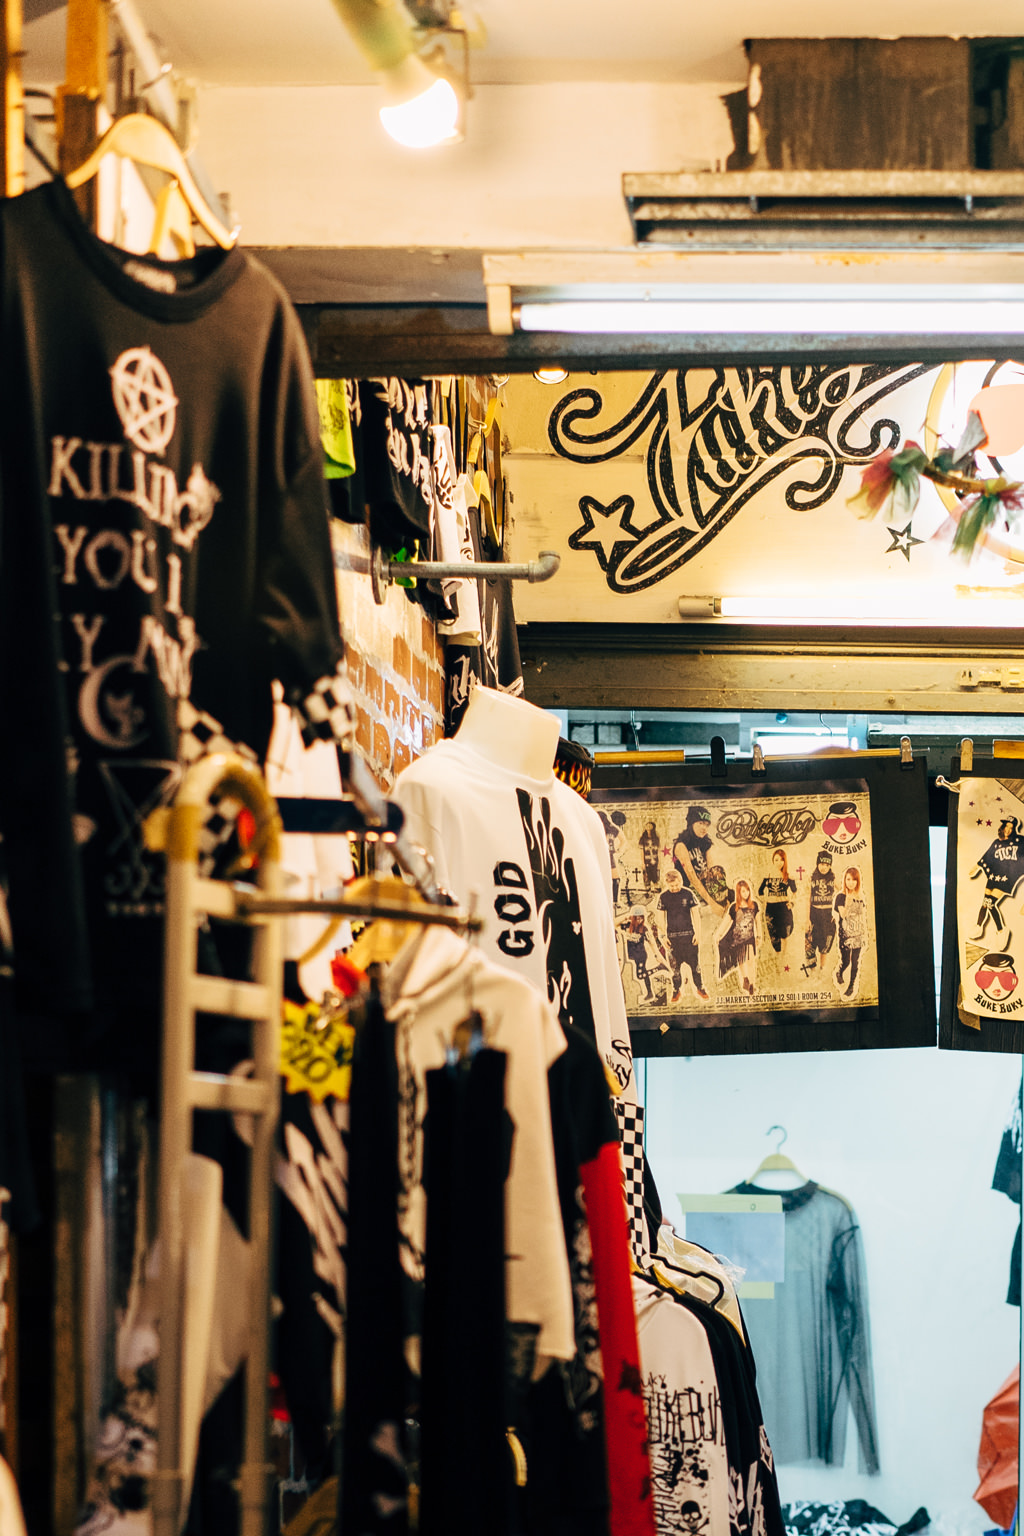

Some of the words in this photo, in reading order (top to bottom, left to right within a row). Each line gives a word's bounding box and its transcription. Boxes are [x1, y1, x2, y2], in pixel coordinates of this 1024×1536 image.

[493, 860, 536, 958] GOD
[752, 994, 777, 1003] SECTION
[778, 994, 785, 1002] 12
[820, 992, 832, 1000] 254
